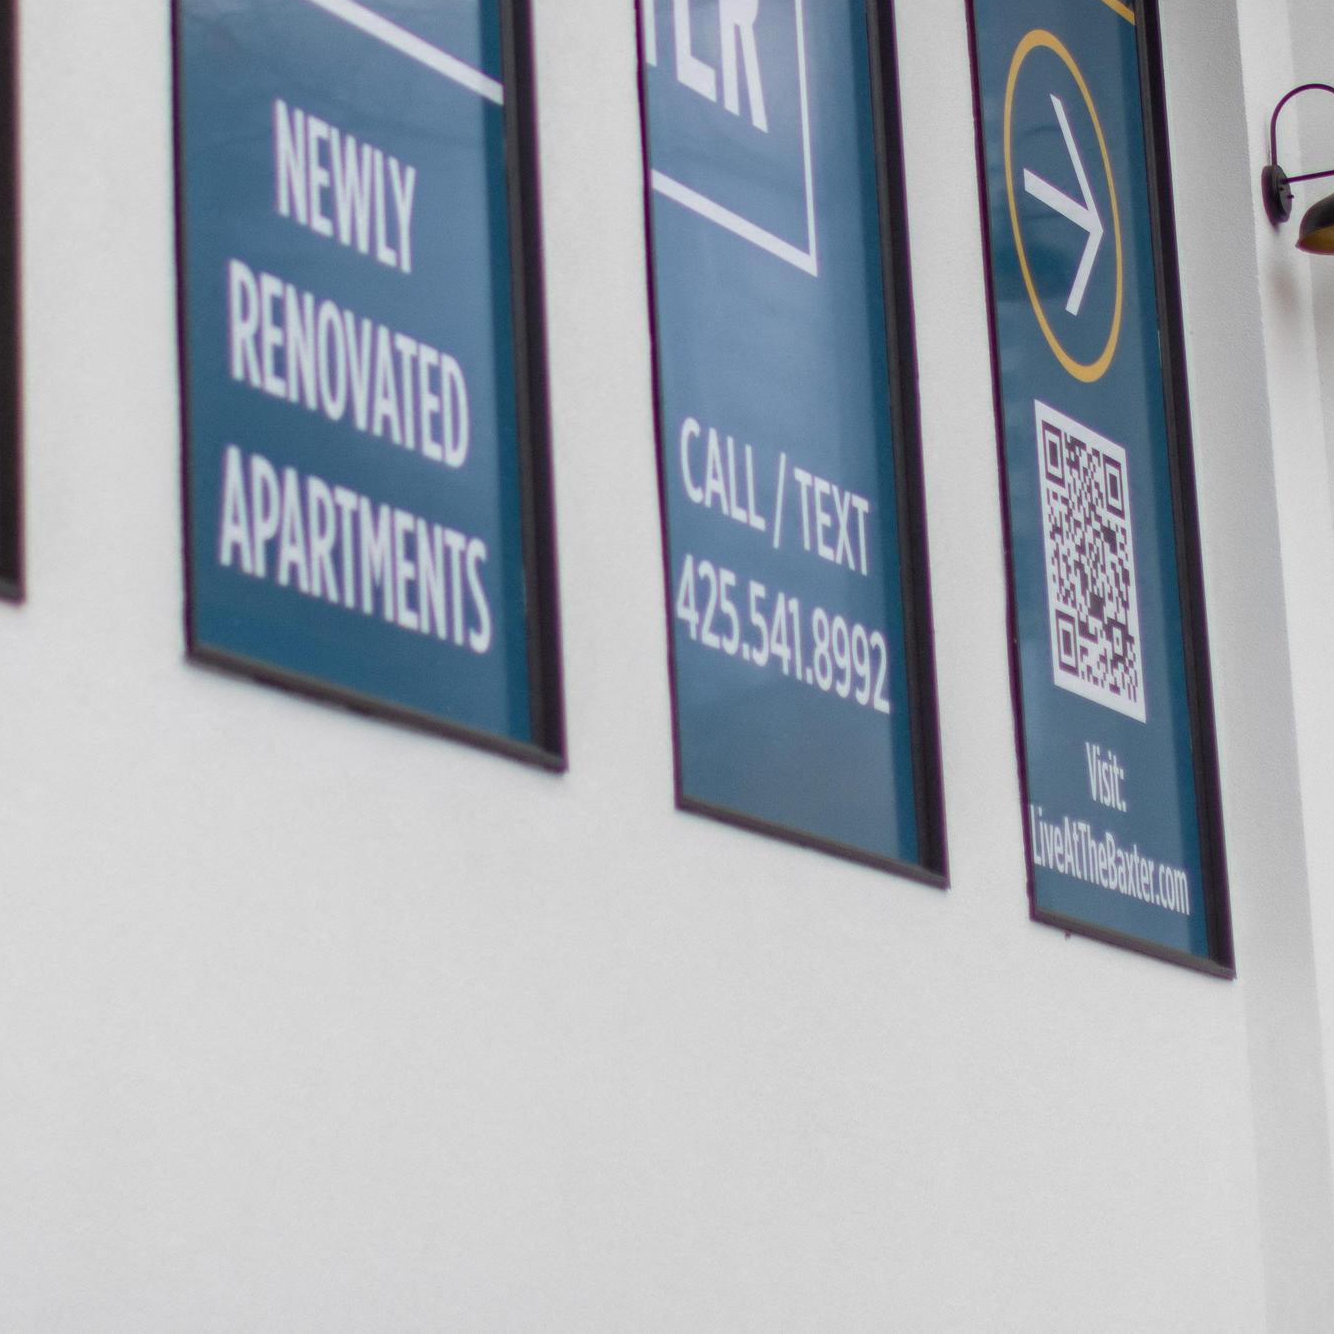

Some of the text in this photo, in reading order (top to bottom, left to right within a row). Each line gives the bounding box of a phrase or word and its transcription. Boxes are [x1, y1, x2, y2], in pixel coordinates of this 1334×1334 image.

[273, 98, 416, 274] NEWLY
[229, 258, 469, 467] RENOVATED
[219, 445, 492, 654] APARTMENTS
[680, 417, 766, 532] CALL
[794, 467, 870, 577] TEXT
[675, 553, 891, 715] 425.541.8992
[1085, 741, 1127, 813] Visit:
[1030, 803, 1191, 916] LiveAtTheBaxter.com
